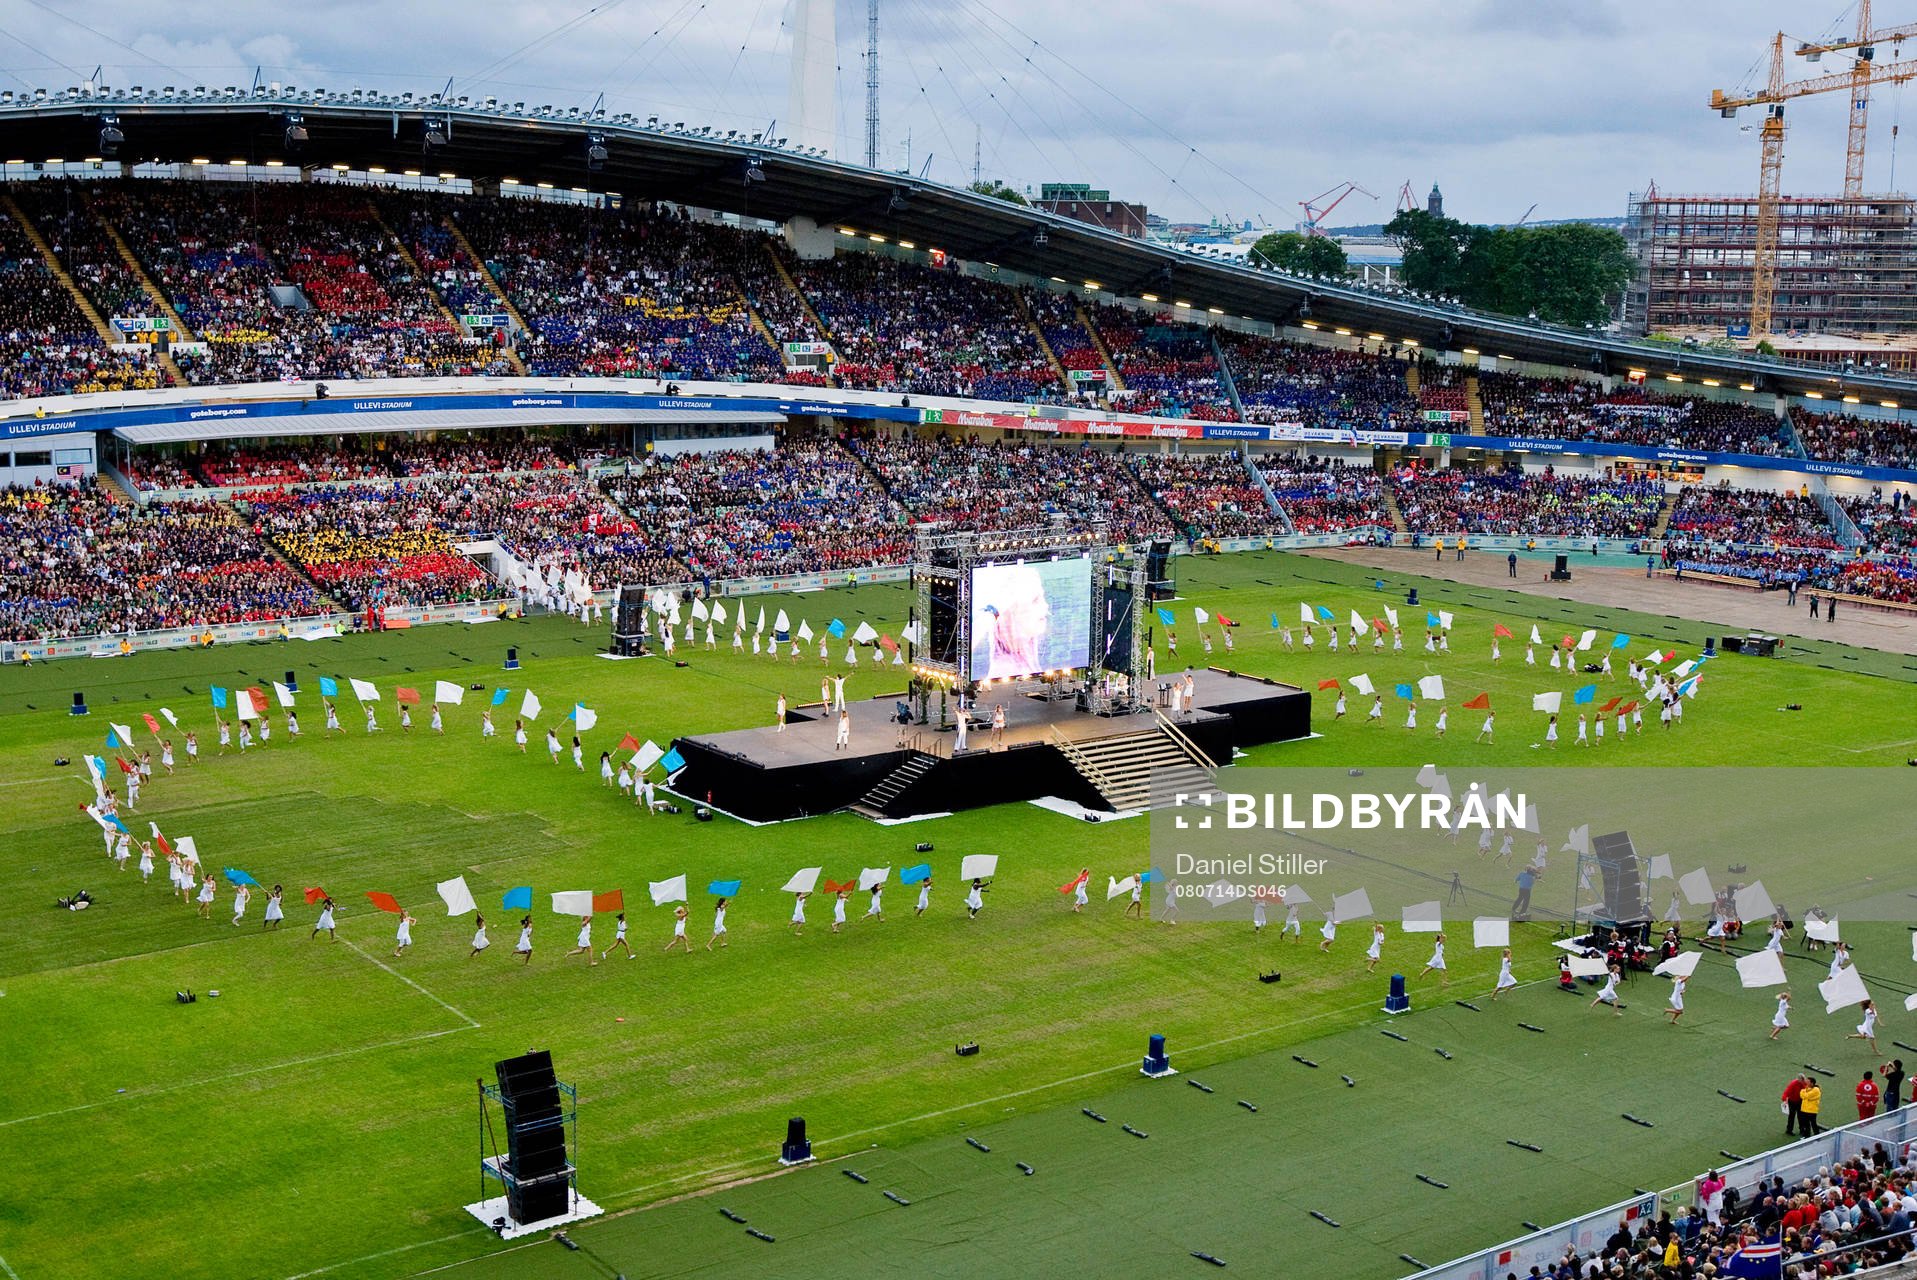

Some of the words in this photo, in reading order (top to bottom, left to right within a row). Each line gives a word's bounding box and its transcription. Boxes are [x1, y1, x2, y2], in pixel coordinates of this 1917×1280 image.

[958, 412, 994, 427] Marabou
[1022, 417, 1058, 432] Marabou
[9, 424, 40, 434] ULLEVI
[40, 422, 76, 431] STADIUM
[1087, 421, 1124, 434] Marabou
[1152, 424, 1188, 438] Marabou
[1806, 464, 1832, 472] ULLEVI
[1832, 466, 1864, 476] STADIUM
